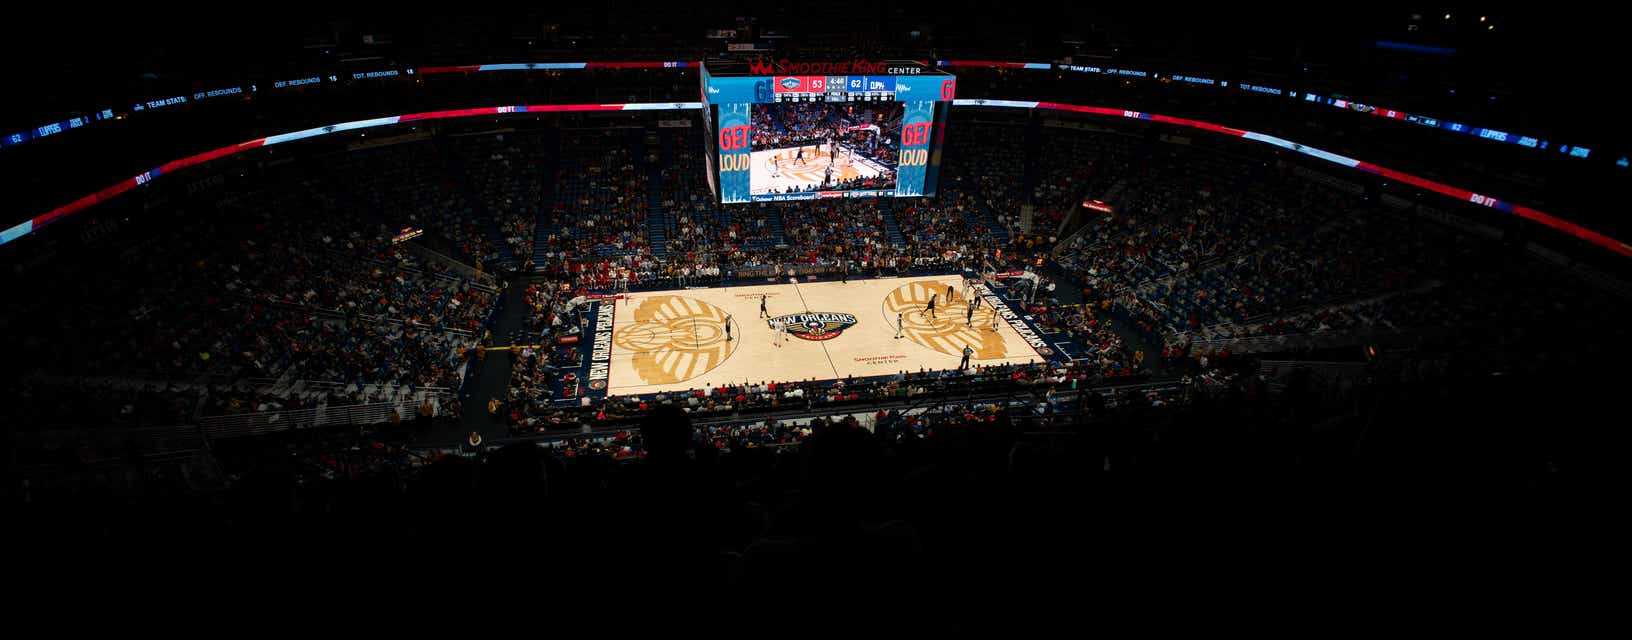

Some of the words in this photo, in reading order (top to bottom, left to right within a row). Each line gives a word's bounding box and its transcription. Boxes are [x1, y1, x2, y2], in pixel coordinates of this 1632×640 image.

[776, 60, 848, 74] SMOOTHIE
[851, 60, 887, 74] KING
[367, 70, 398, 78] REBOUNDS
[288, 77, 320, 86] REBOUNDS
[812, 80, 823, 88] 53
[851, 80, 861, 88] 62
[208, 87, 241, 97] REBOUNDS
[146, 98, 165, 109] TEAM
[12, 134, 22, 143] 62
[720, 126, 750, 150] GET
[902, 122, 932, 145] GET
[720, 153, 750, 171] LOUD
[900, 150, 928, 166] LOUD
[136, 175, 145, 185] DO
[145, 172, 151, 181] IT
[1470, 193, 1484, 204] DO
[1485, 197, 1496, 207] IT
[596, 304, 614, 331] PELICANS
[801, 313, 856, 323] ORLEANS
[592, 332, 612, 361] ORLEANS
[590, 362, 609, 380] NEW
